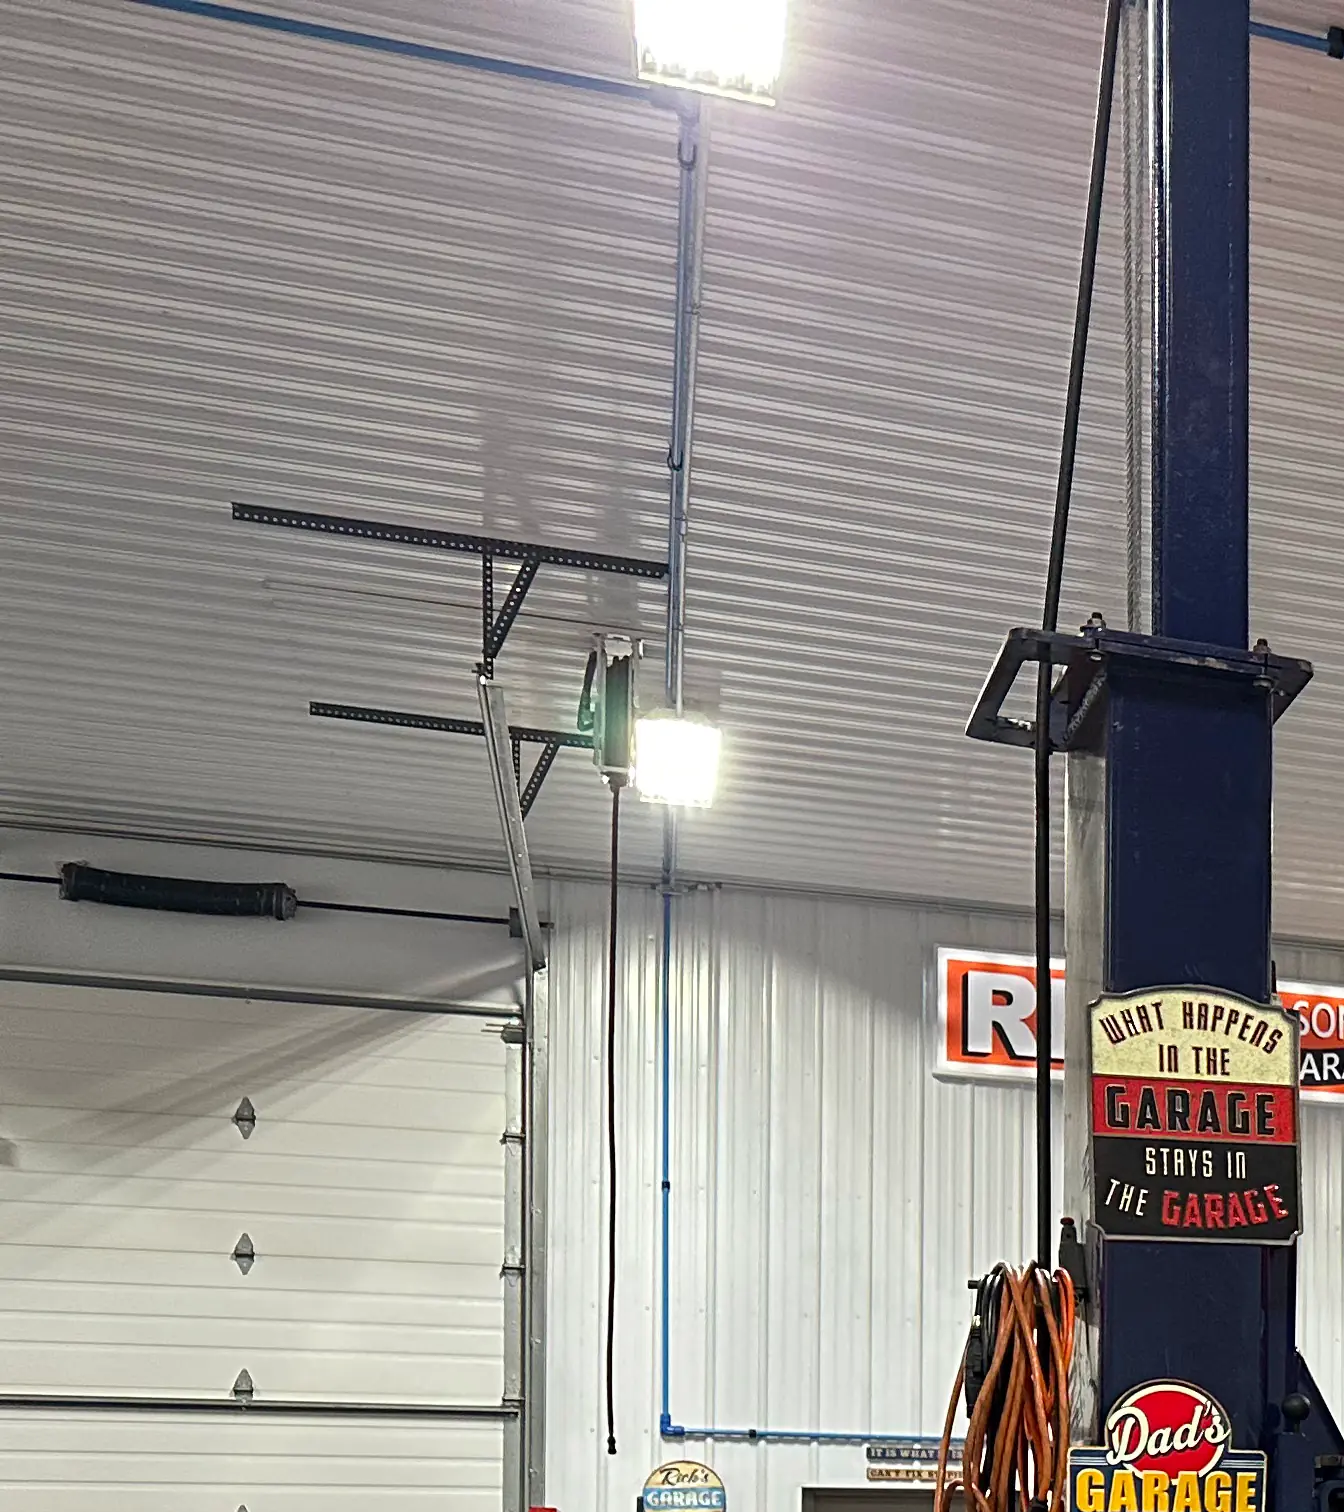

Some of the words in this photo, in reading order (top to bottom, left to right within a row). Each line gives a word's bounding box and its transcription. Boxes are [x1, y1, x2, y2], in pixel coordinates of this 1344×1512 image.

[1099, 1000, 1164, 1045] WHAT
[1182, 1001, 1284, 1054] HAPPENS
[1158, 1044, 1179, 1073] IN
[1192, 1046, 1230, 1075] THE
[1105, 1084, 1275, 1136] GARAGE
[1145, 1147, 1213, 1178] STAYS
[1227, 1151, 1246, 1179] IN
[1104, 1178, 1149, 1216] THE
[1161, 1184, 1289, 1229] GARAGE
[1105, 1400, 1231, 1466] Dad's
[900, 1449, 935, 1458] WHAT
[660, 1467, 709, 1486] Rick's
[646, 1490, 722, 1507] GARAGE
